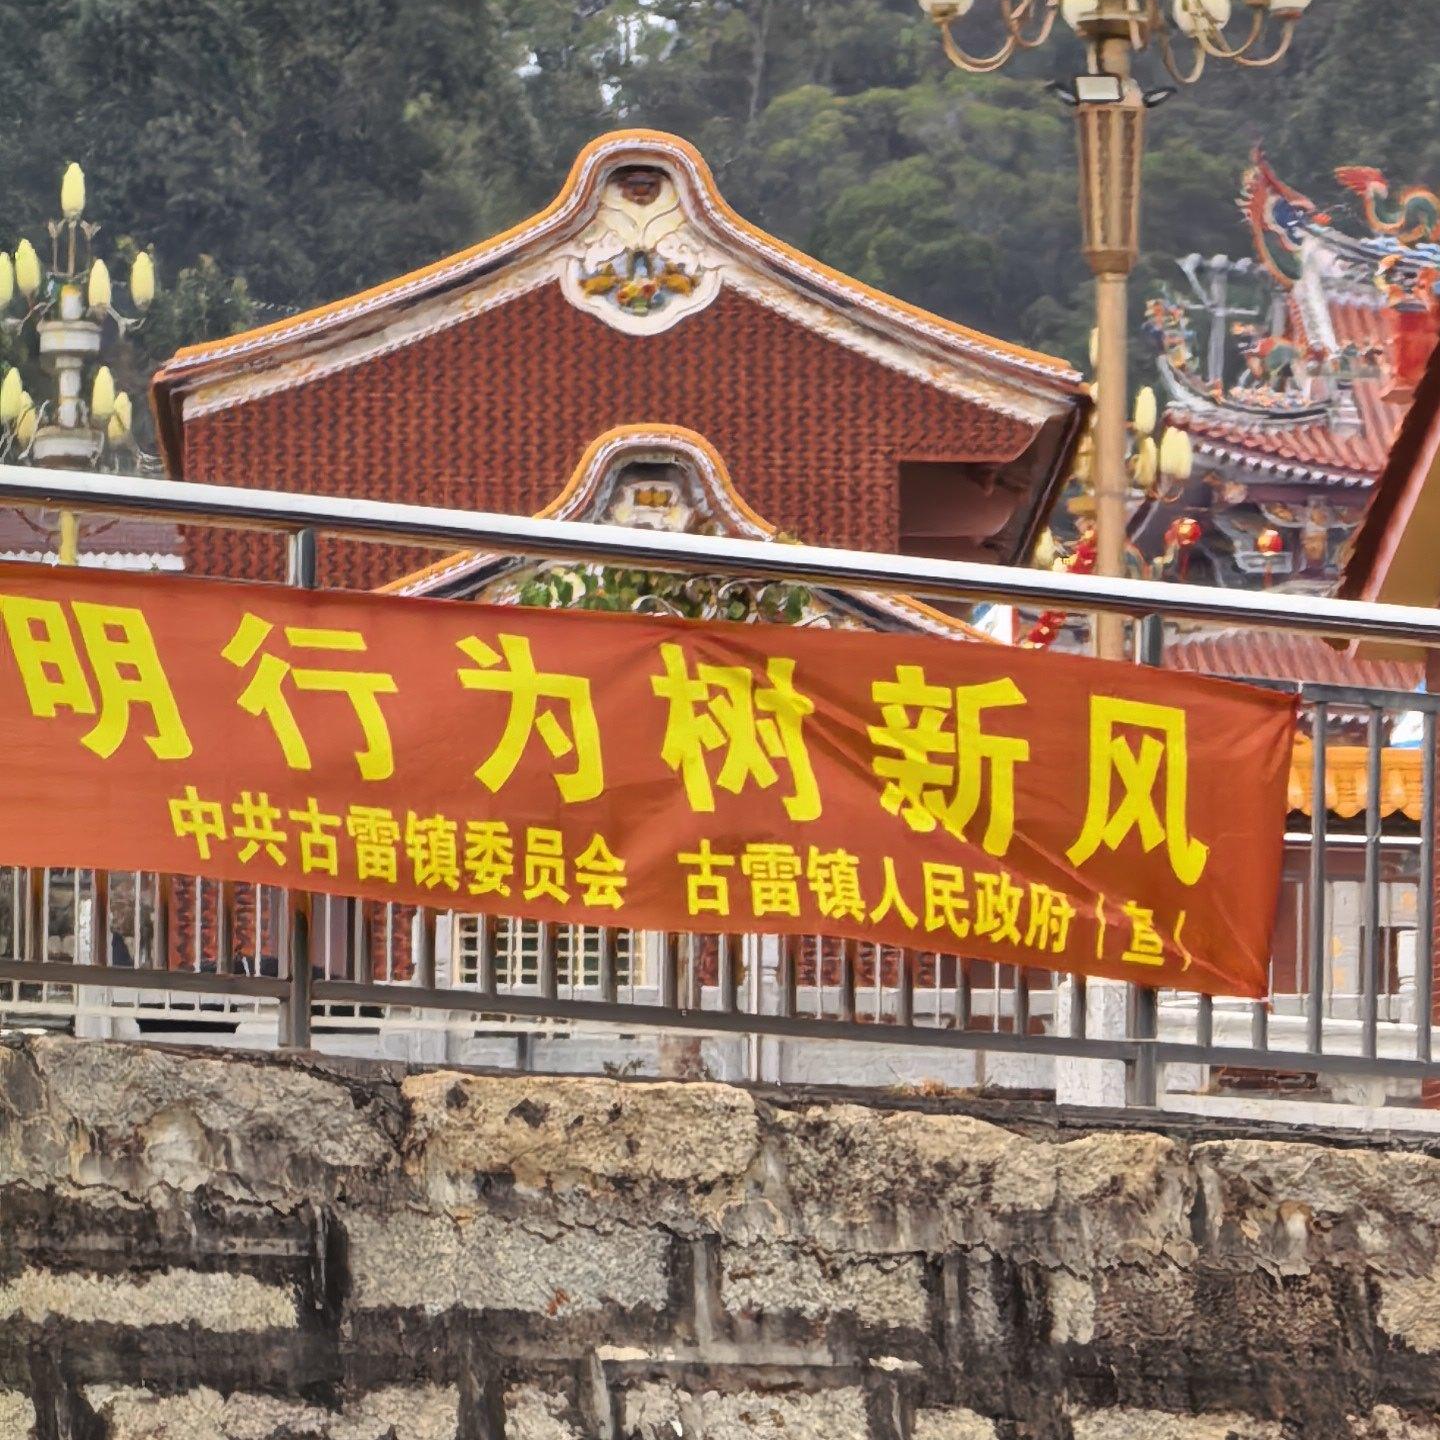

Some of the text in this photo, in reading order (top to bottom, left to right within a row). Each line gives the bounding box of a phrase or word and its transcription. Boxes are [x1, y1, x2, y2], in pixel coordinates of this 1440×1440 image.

[0, 593, 1209, 886] 明行为树新风
[167, 784, 628, 911] 中共古雷镇委员会
